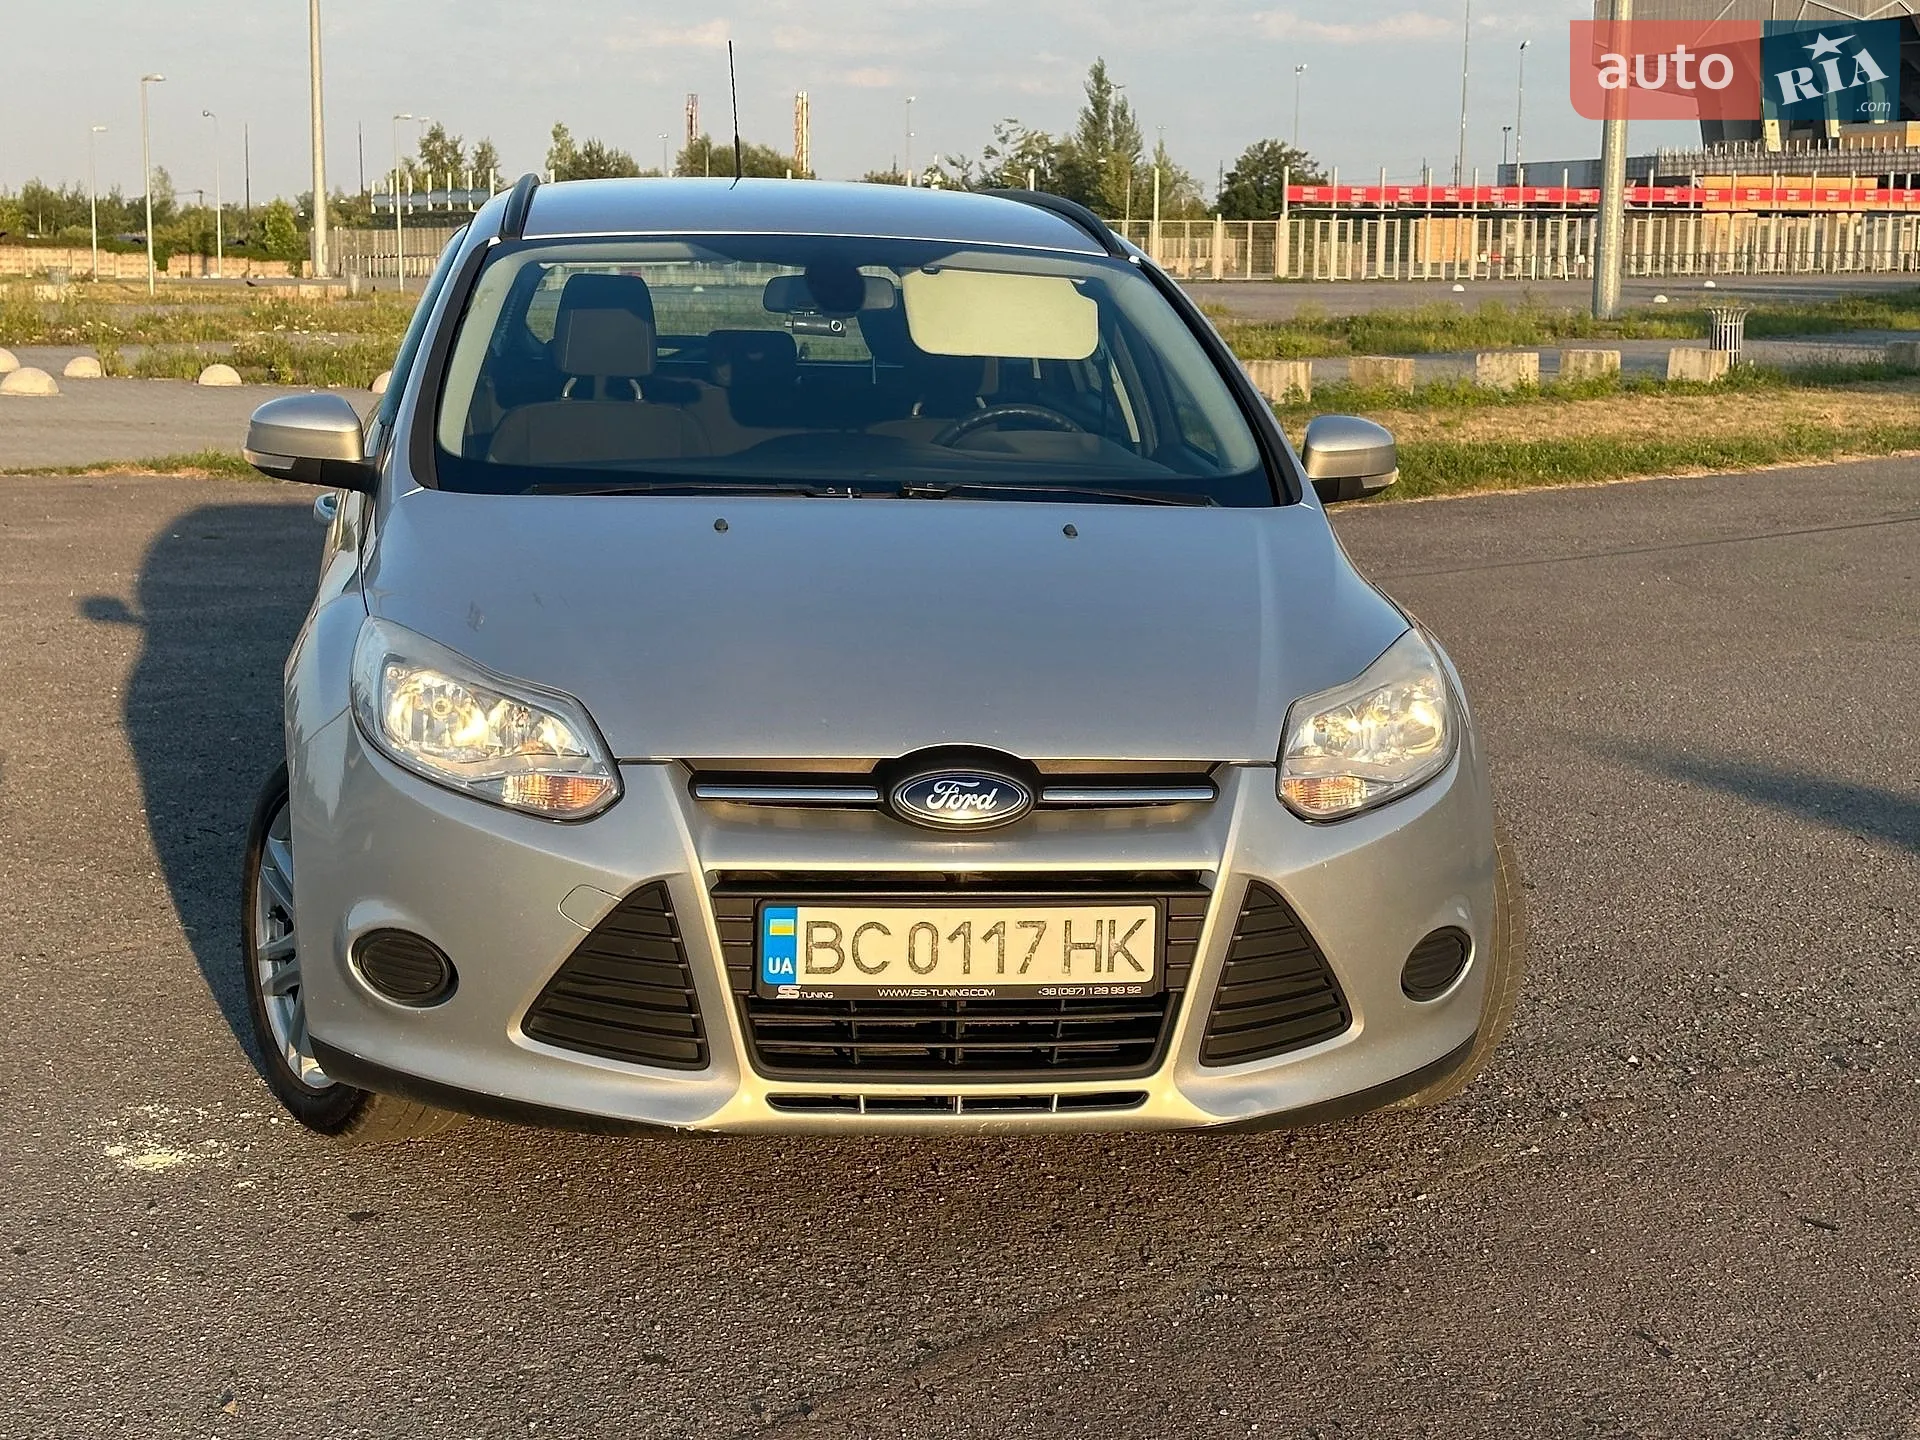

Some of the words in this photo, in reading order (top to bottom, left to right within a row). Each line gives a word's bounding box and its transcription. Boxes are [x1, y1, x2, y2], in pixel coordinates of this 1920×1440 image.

[926, 780, 999, 811] Ford
[804, 920, 892, 975] BC
[907, 920, 1047, 975] 0117
[1063, 918, 1148, 975] HK
[768, 957, 794, 975] UA
[800, 991, 834, 999] TUNING
[877, 988, 996, 997] WWW.SS-TUNING.COM
[1089, 986, 1109, 995] 129
